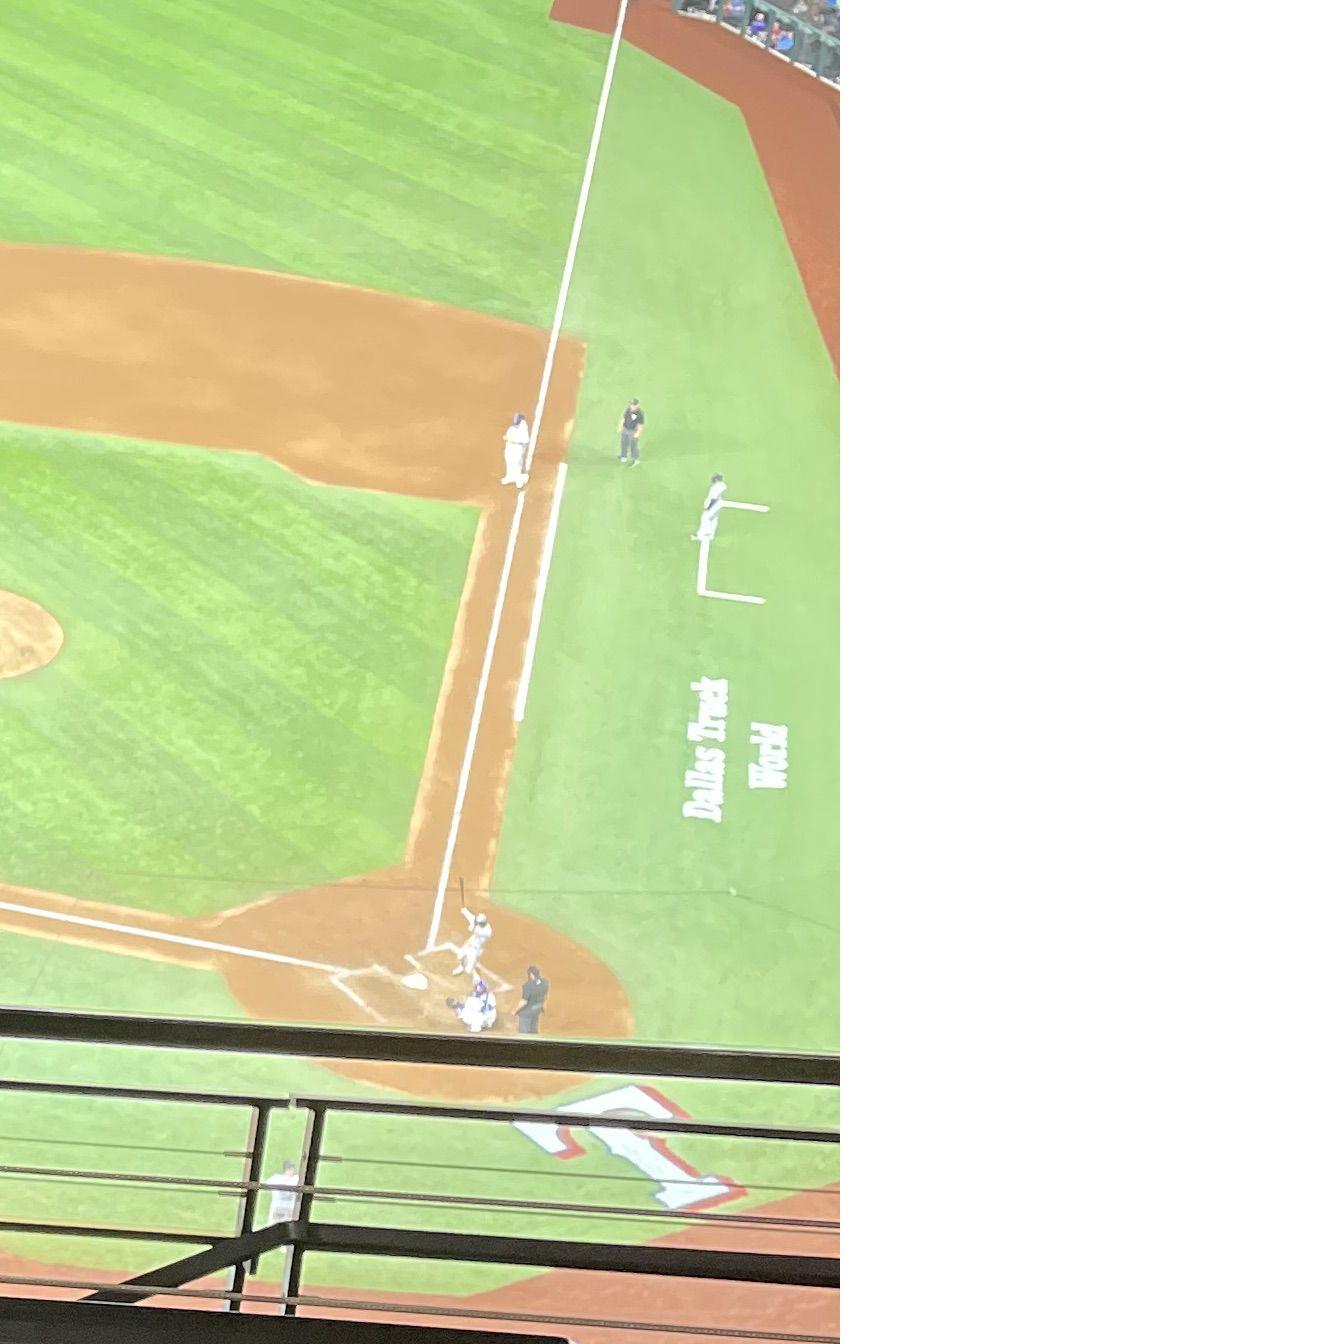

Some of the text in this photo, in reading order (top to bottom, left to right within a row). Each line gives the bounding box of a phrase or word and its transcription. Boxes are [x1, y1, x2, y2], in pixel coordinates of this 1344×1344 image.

[682, 675, 730, 824] Dallas Truck
[747, 719, 790, 790] World
